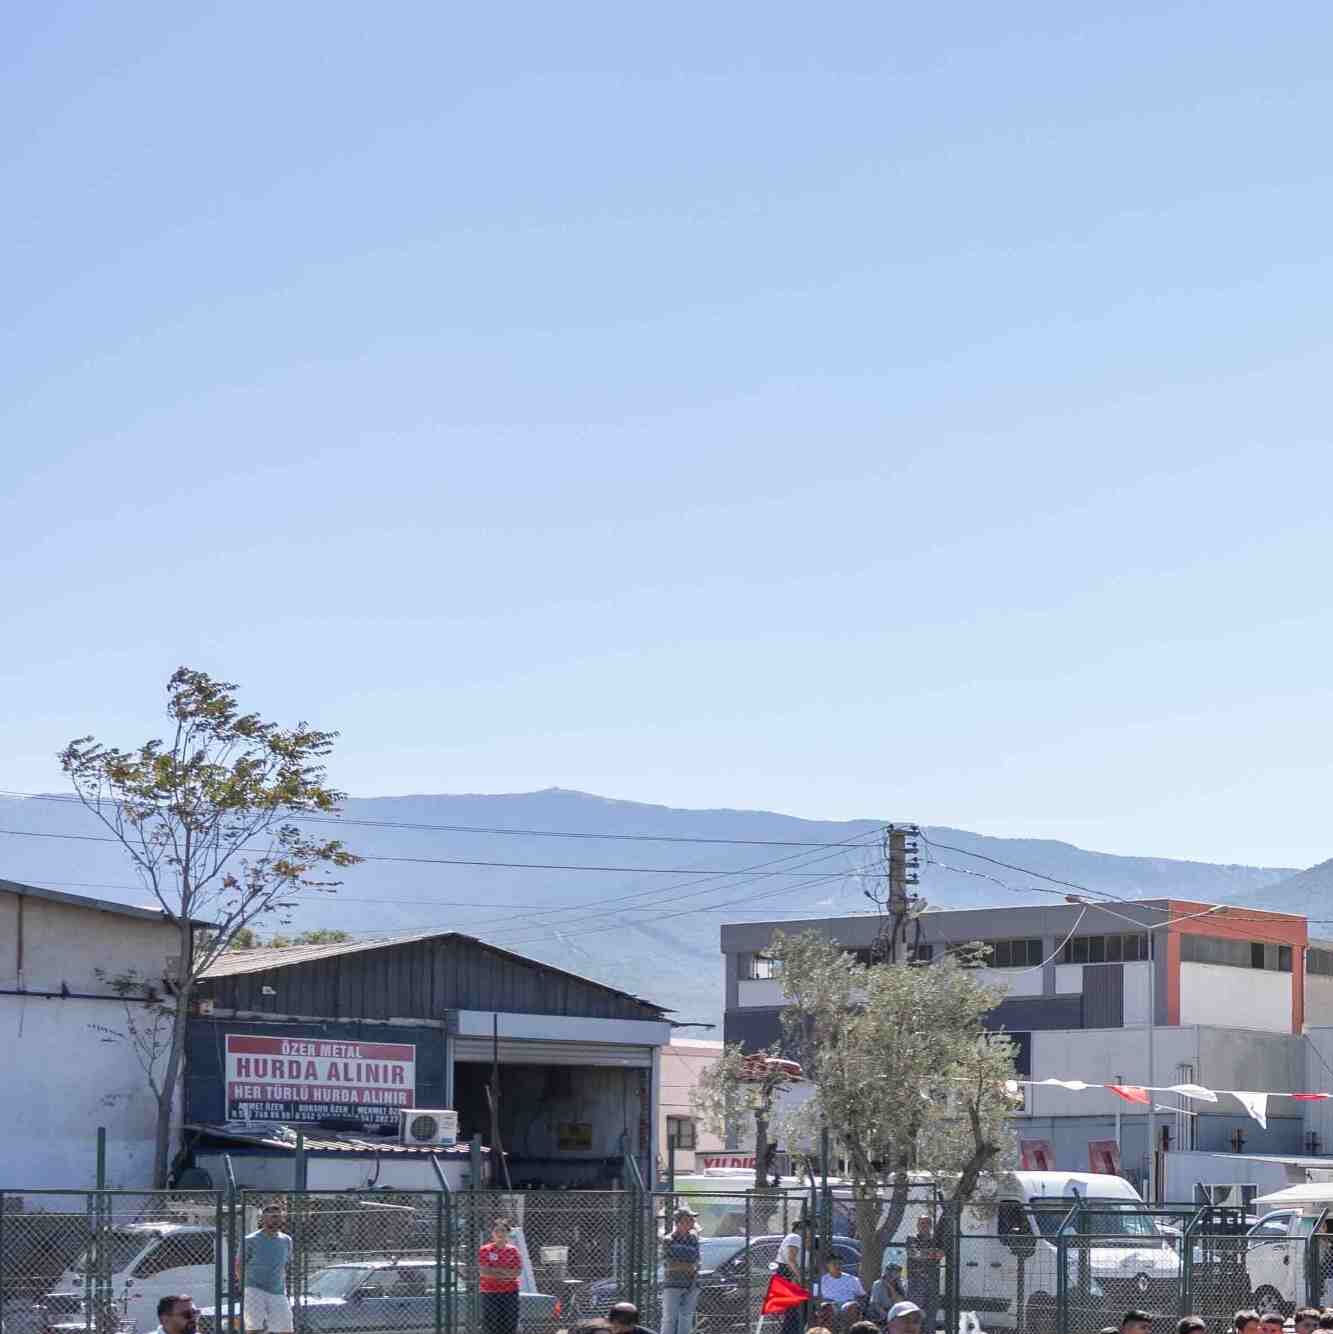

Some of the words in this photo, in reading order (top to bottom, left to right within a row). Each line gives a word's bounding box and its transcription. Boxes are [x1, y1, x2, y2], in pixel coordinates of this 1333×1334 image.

[281, 1039, 315, 1057] ÖZER
[319, 1043, 362, 1058] METAL
[236, 1057, 319, 1080] HURDA
[327, 1062, 406, 1085] ALINIR
[234, 1085, 262, 1099] HER
[266, 1084, 309, 1100] TÜRLÜ
[313, 1087, 360, 1103] HURDA
[363, 1091, 407, 1104] ALINIR
